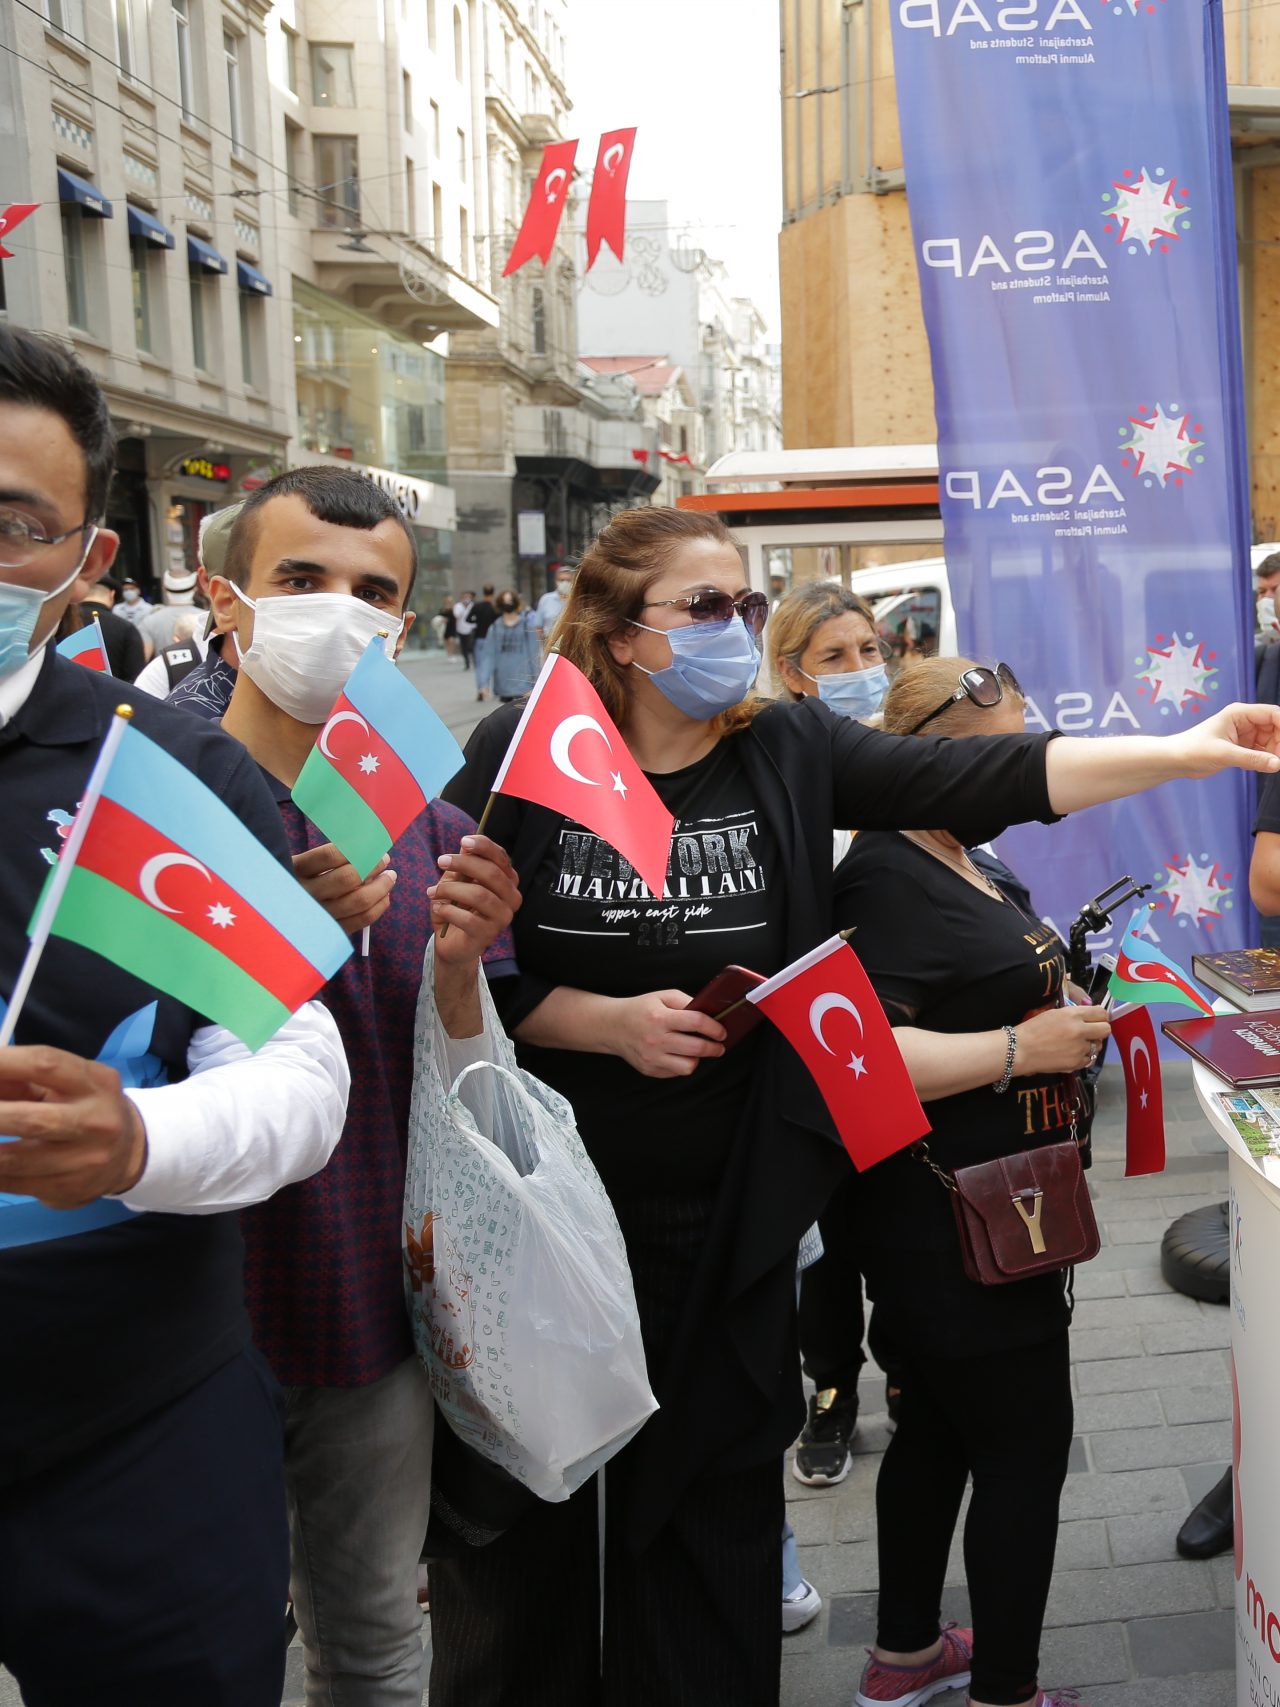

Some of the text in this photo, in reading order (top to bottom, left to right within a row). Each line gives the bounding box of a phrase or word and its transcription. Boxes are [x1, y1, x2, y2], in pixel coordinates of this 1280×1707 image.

[601, 903, 713, 923] upper east side
[637, 923, 679, 945] 212
